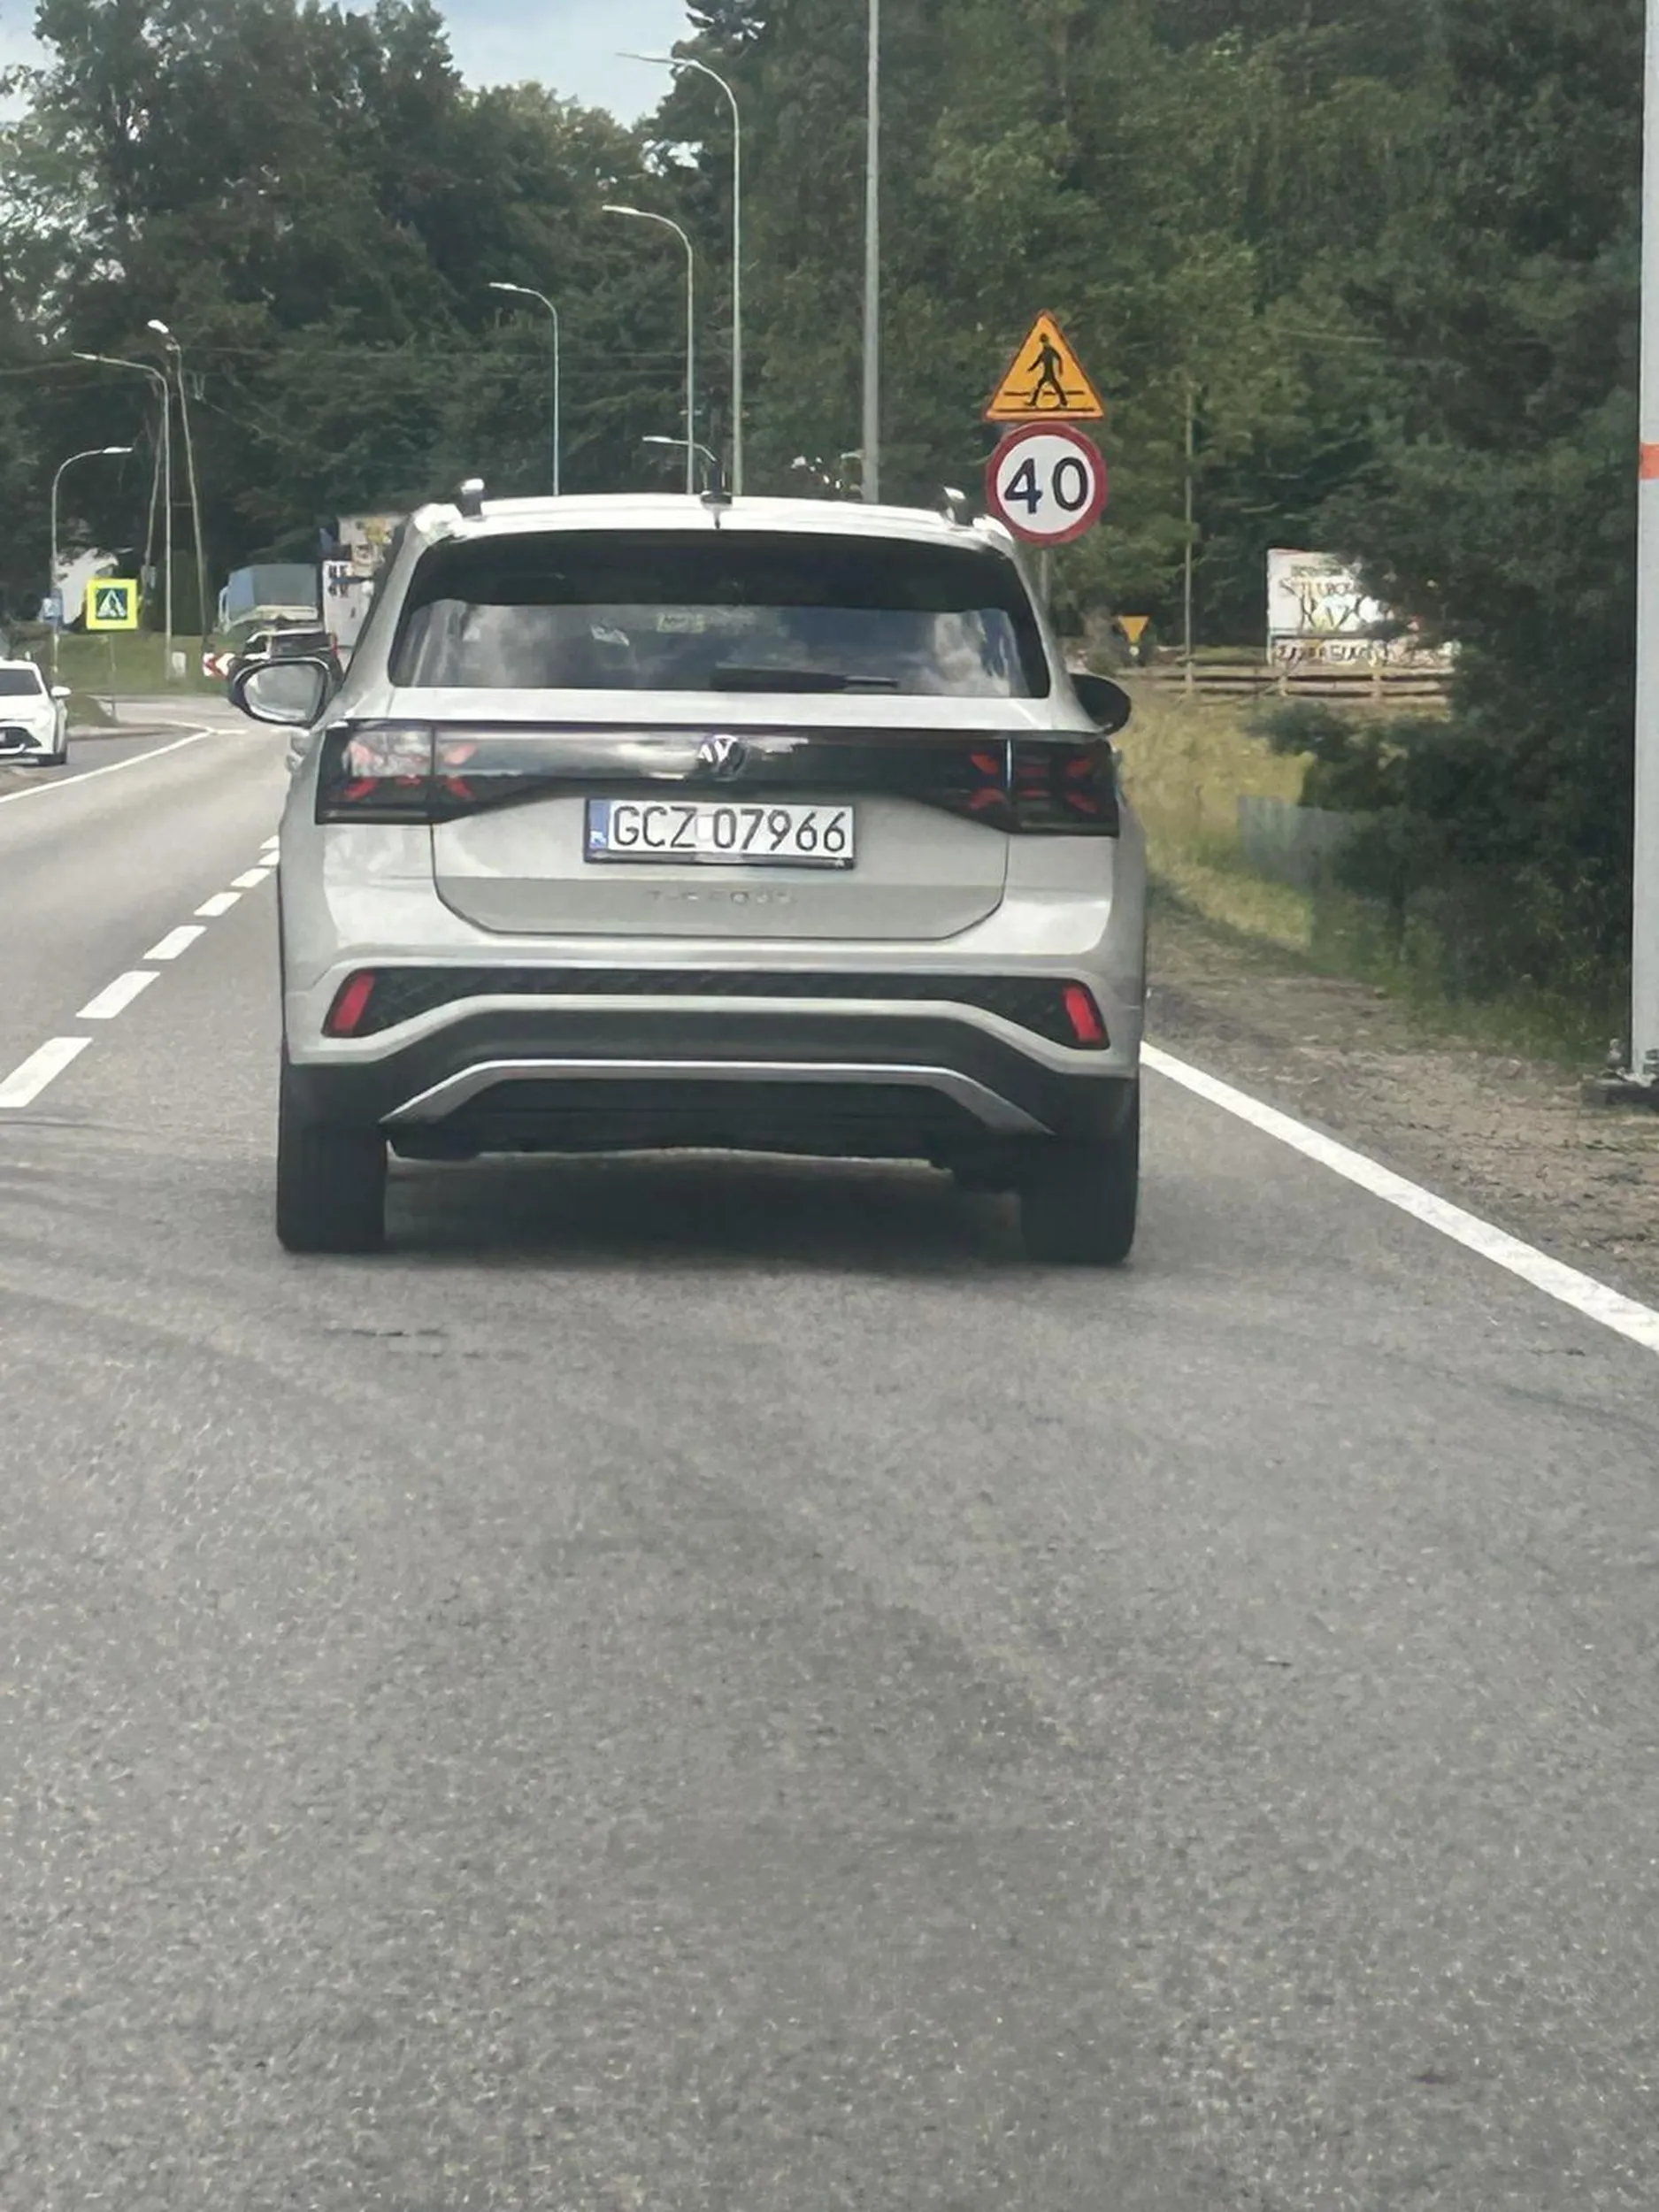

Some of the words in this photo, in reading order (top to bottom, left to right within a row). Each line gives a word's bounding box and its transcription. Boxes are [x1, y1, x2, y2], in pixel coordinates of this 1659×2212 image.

[1004, 457, 1088, 514] 40
[613, 805, 697, 849] GCZ
[712, 808, 846, 853] 07966
